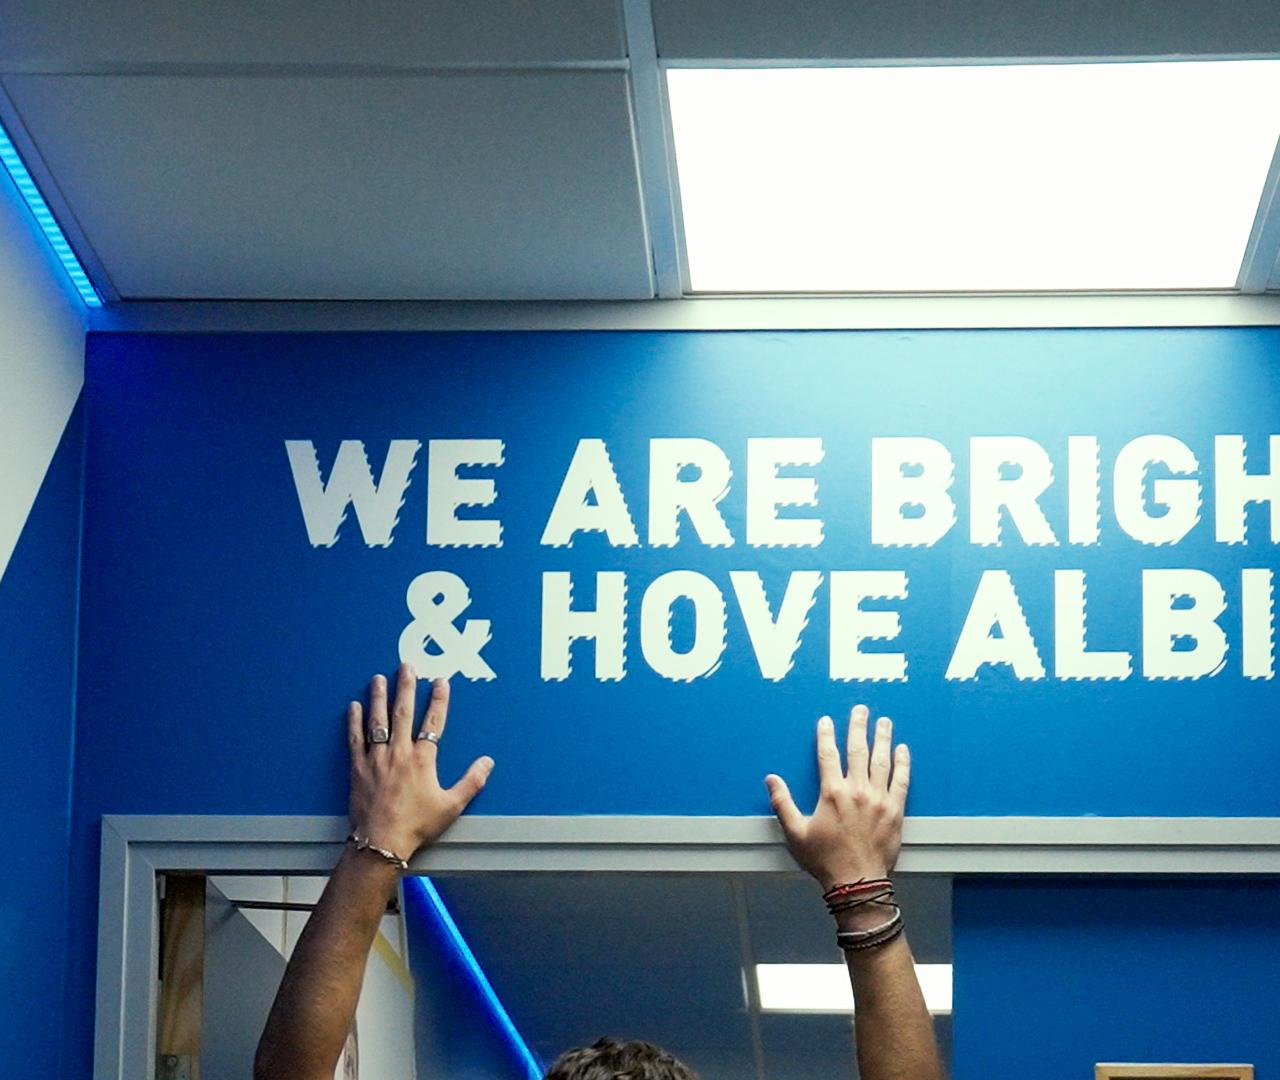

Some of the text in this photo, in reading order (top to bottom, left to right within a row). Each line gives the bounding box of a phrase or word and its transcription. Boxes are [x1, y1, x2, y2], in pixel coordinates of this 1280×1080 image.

[285, 438, 506, 549] WE
[540, 437, 824, 548] ARE
[398, 570, 497, 682] &
[540, 570, 910, 684] HOVE
